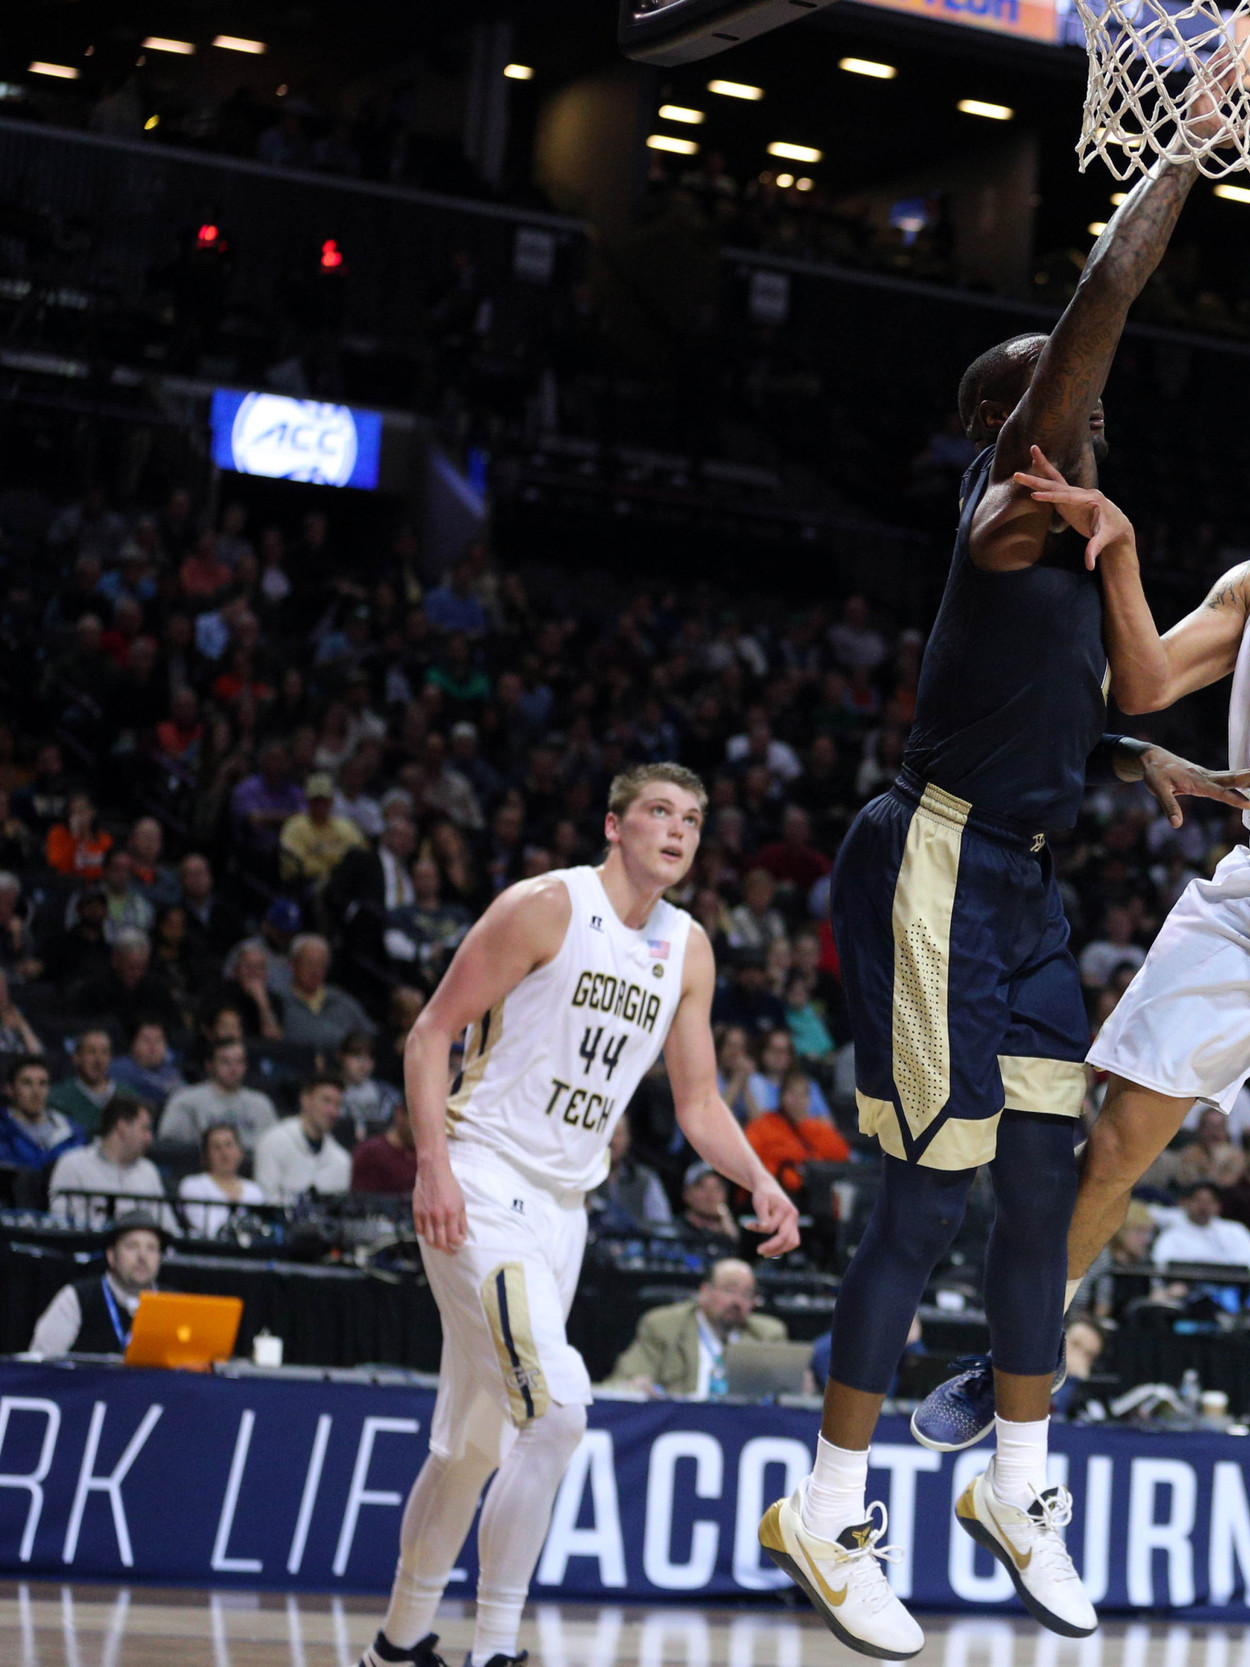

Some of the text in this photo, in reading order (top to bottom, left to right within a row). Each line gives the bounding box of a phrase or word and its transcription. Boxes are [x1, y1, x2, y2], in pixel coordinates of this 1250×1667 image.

[250, 421, 343, 456] ACC
[571, 970, 662, 1035] GEORGIA
[578, 1026, 629, 1081] 44
[545, 1079, 616, 1134] TECH
[210, 1409, 468, 1580] LIF
